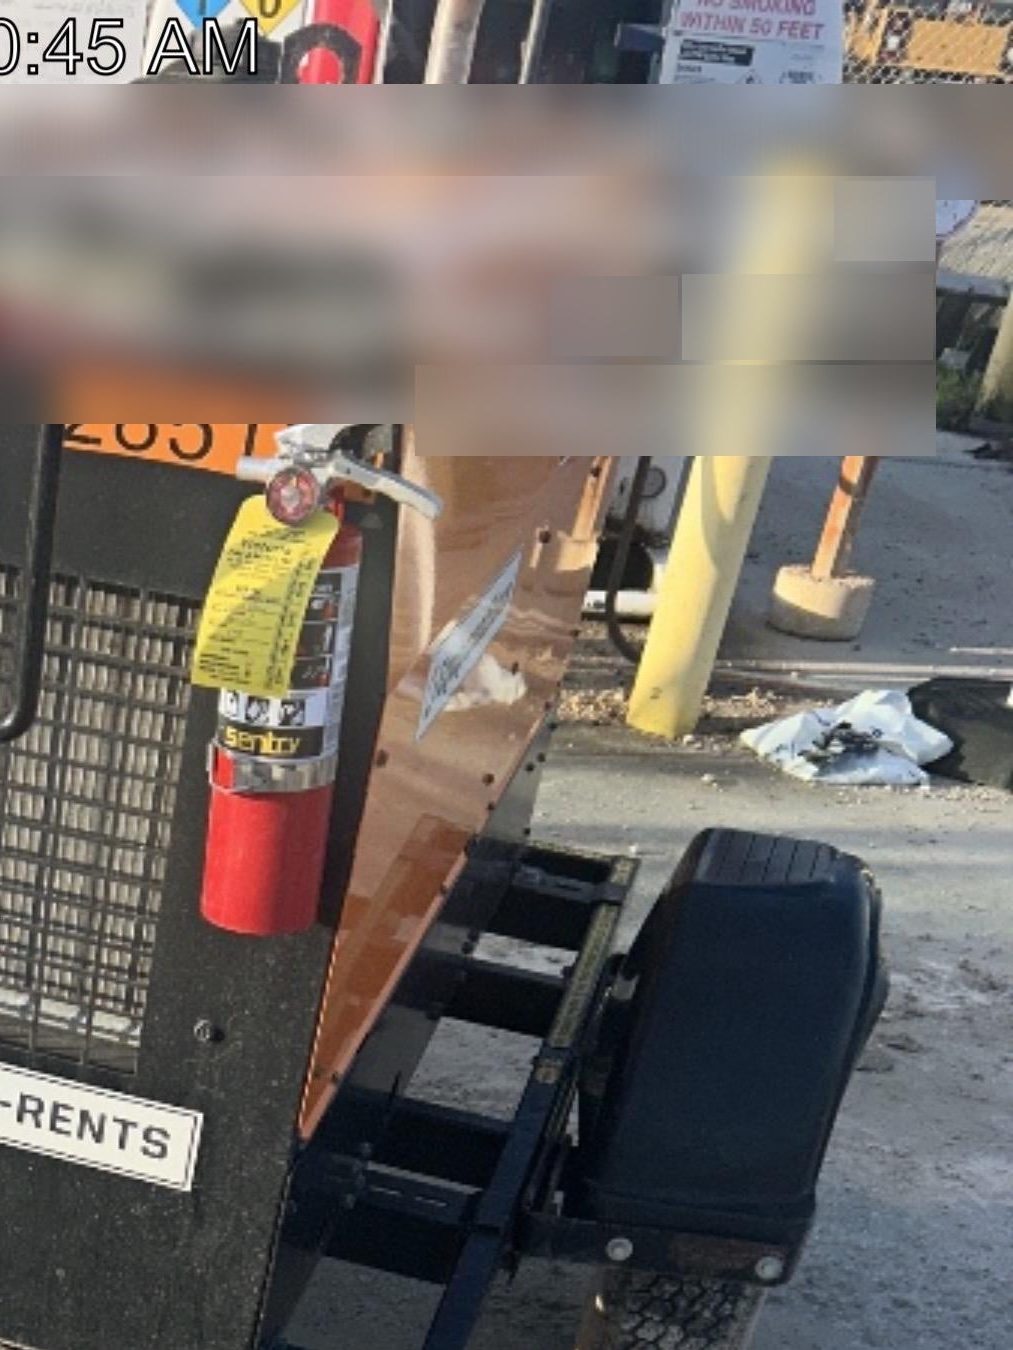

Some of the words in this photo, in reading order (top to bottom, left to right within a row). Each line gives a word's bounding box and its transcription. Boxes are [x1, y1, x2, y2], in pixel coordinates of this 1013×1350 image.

[681, 11, 746, 33] WITHIN
[749, 17, 771, 37] 50
[776, 21, 825, 40] FEET
